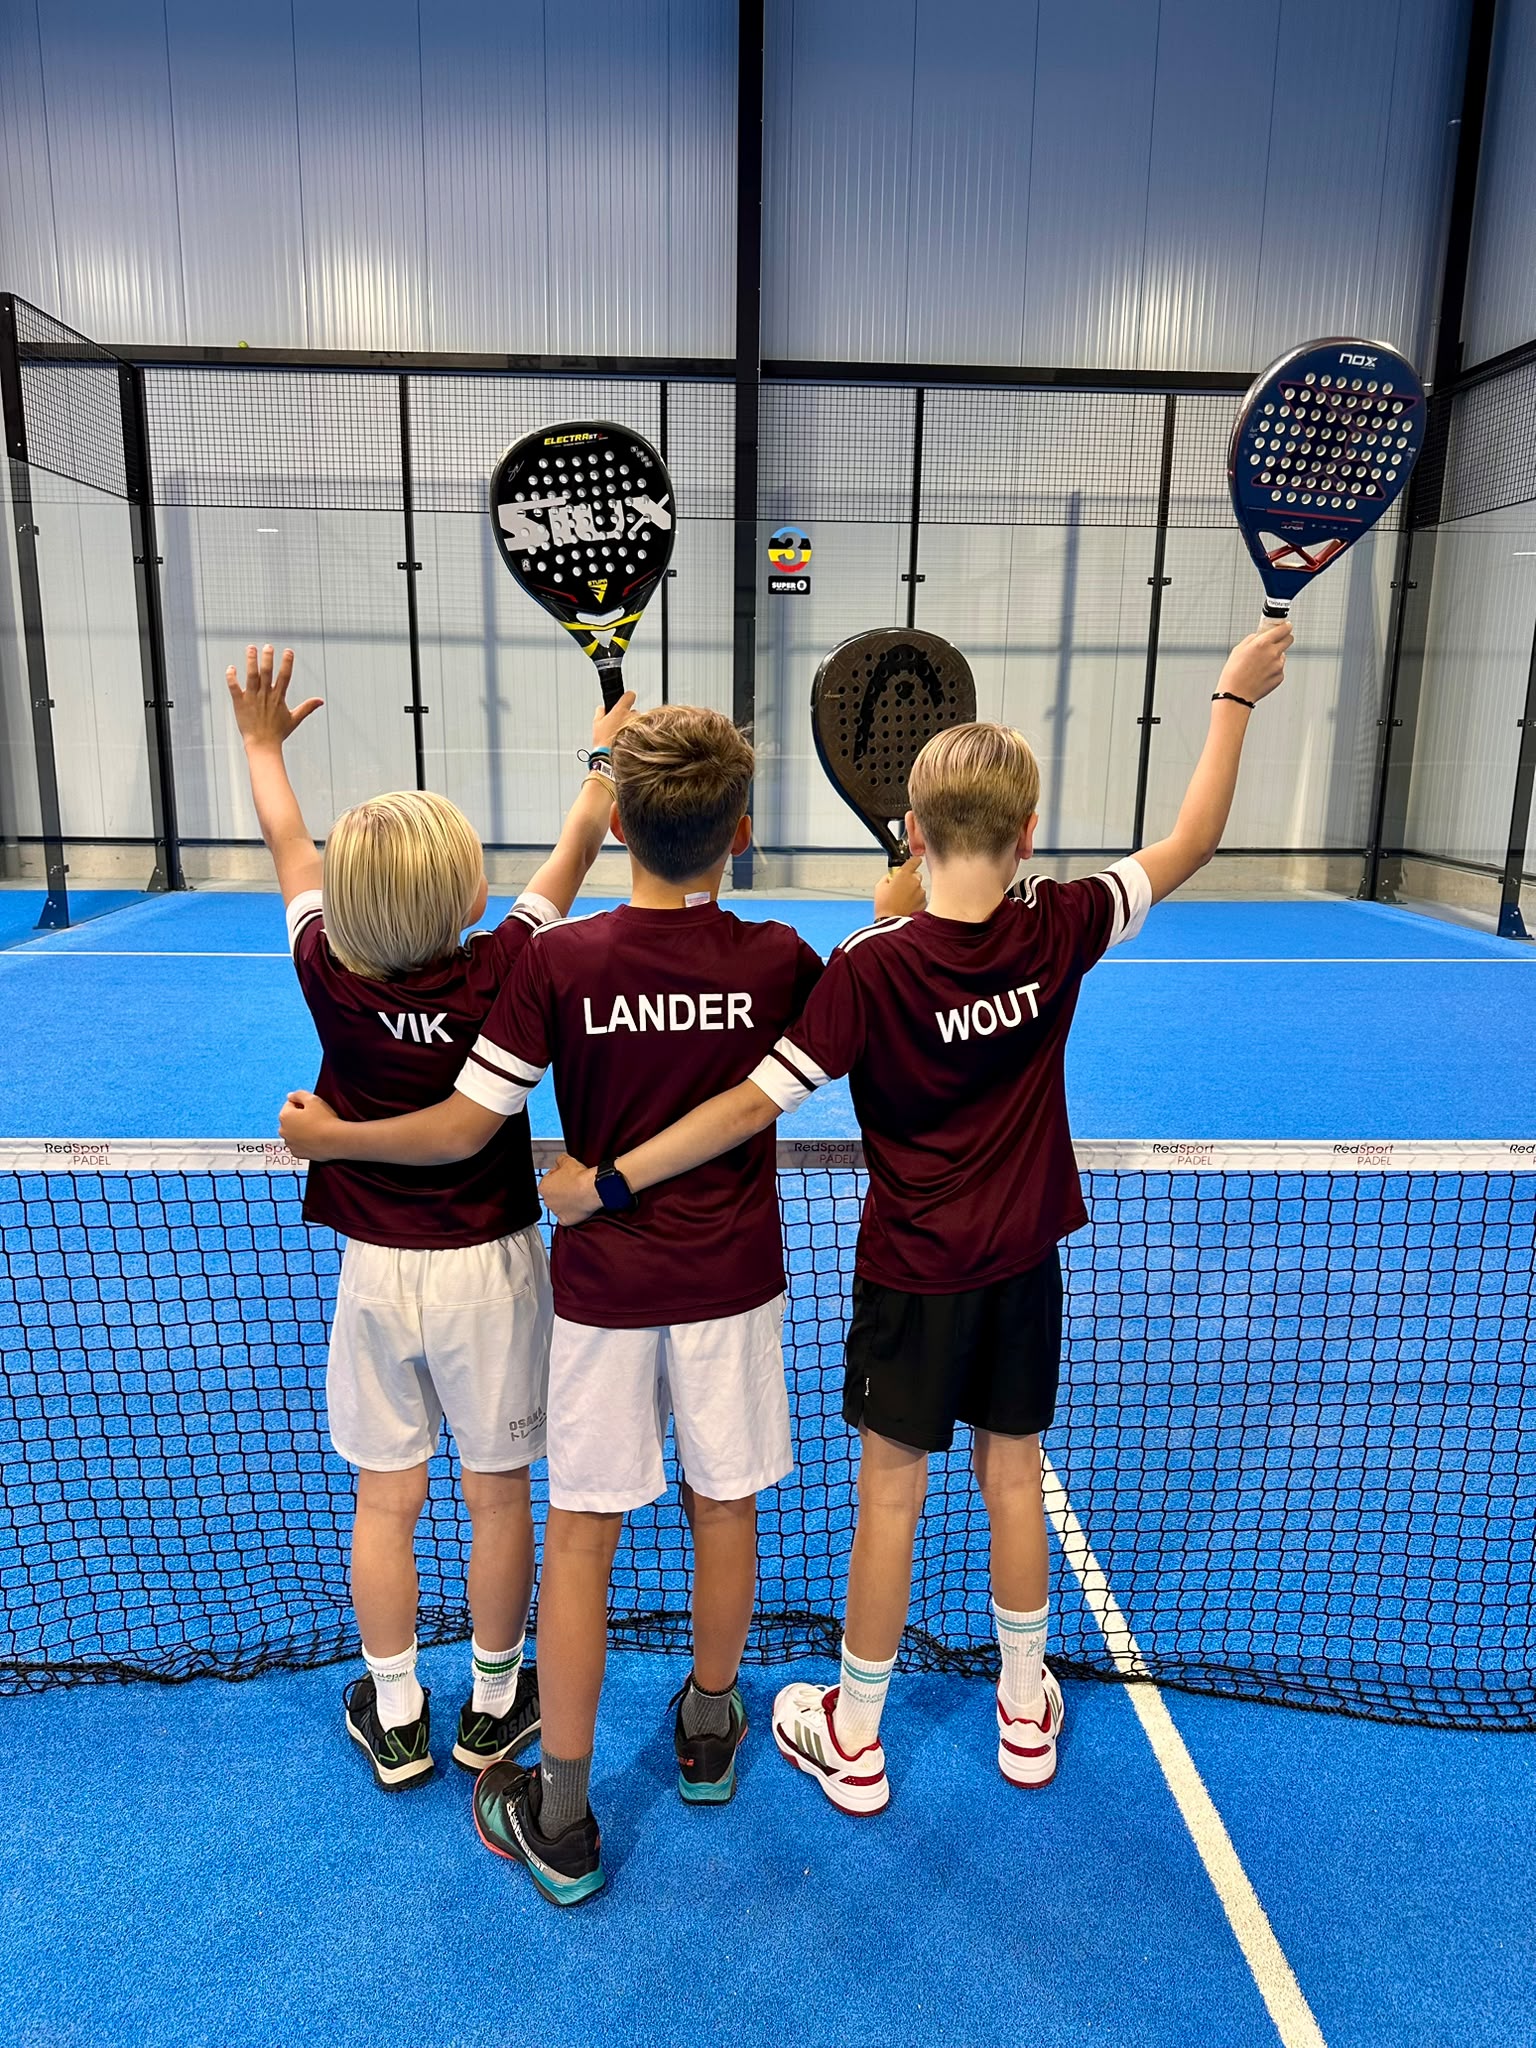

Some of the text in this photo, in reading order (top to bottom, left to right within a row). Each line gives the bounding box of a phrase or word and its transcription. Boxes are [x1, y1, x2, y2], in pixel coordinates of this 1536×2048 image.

[771, 581, 797, 589] SUPER
[583, 992, 755, 1035] LANDER
[935, 982, 1040, 1044] WOUT
[377, 1011, 454, 1044] VIK
[44, 1142, 111, 1155] RedSport
[236, 1143, 291, 1156] RedSpo
[794, 1143, 855, 1154] RedSport
[1153, 1143, 1215, 1156] RedSport
[1333, 1144, 1394, 1156] RedSport
[73, 1155, 111, 1166] PADEL
[265, 1155, 303, 1166] PADEL
[820, 1154, 855, 1164] PADEL
[1177, 1155, 1213, 1166] PADEL
[1357, 1156, 1392, 1166] PADEL
